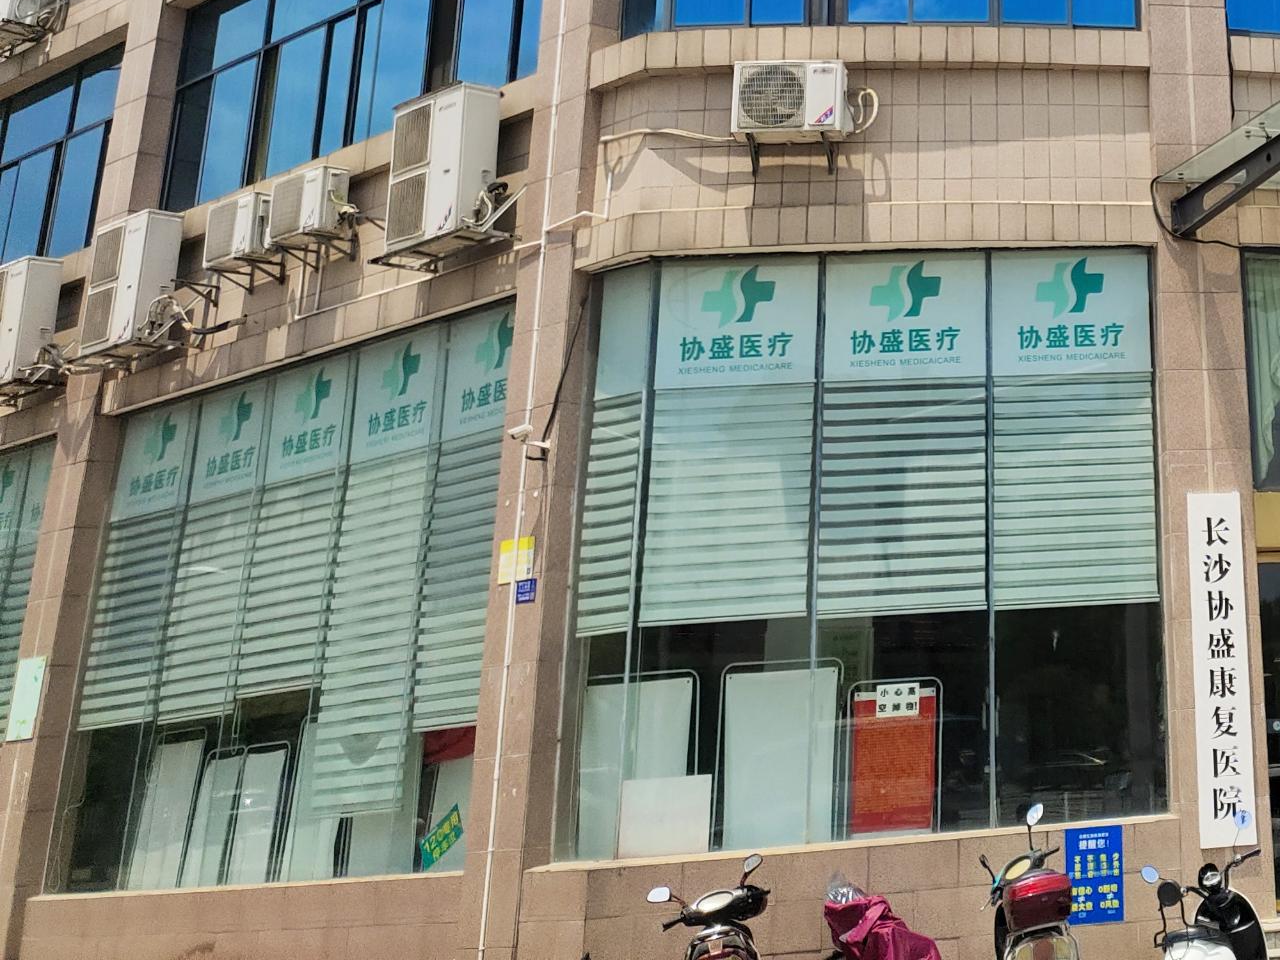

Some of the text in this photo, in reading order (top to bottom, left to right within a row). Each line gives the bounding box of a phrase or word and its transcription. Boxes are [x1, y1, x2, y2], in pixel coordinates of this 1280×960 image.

[680, 332, 794, 362] 协盛医疗
[850, 326, 961, 355] 协盛医疗
[1017, 323, 1125, 350] 协盛医疗
[679, 365, 725, 375] XIESHENG
[849, 359, 896, 368] XIESHENG
[1018, 353, 1062, 362] XIESHENG
[368, 400, 427, 437] 协盛医疗
[282, 424, 337, 458] 协盛医疗
[206, 446, 257, 478] 协盛医疗
[129, 466, 180, 497] 协盛医疗
[1202, 515, 1242, 820] 长沙协盛康复医院
[880, 686, 916, 698] 小心高
